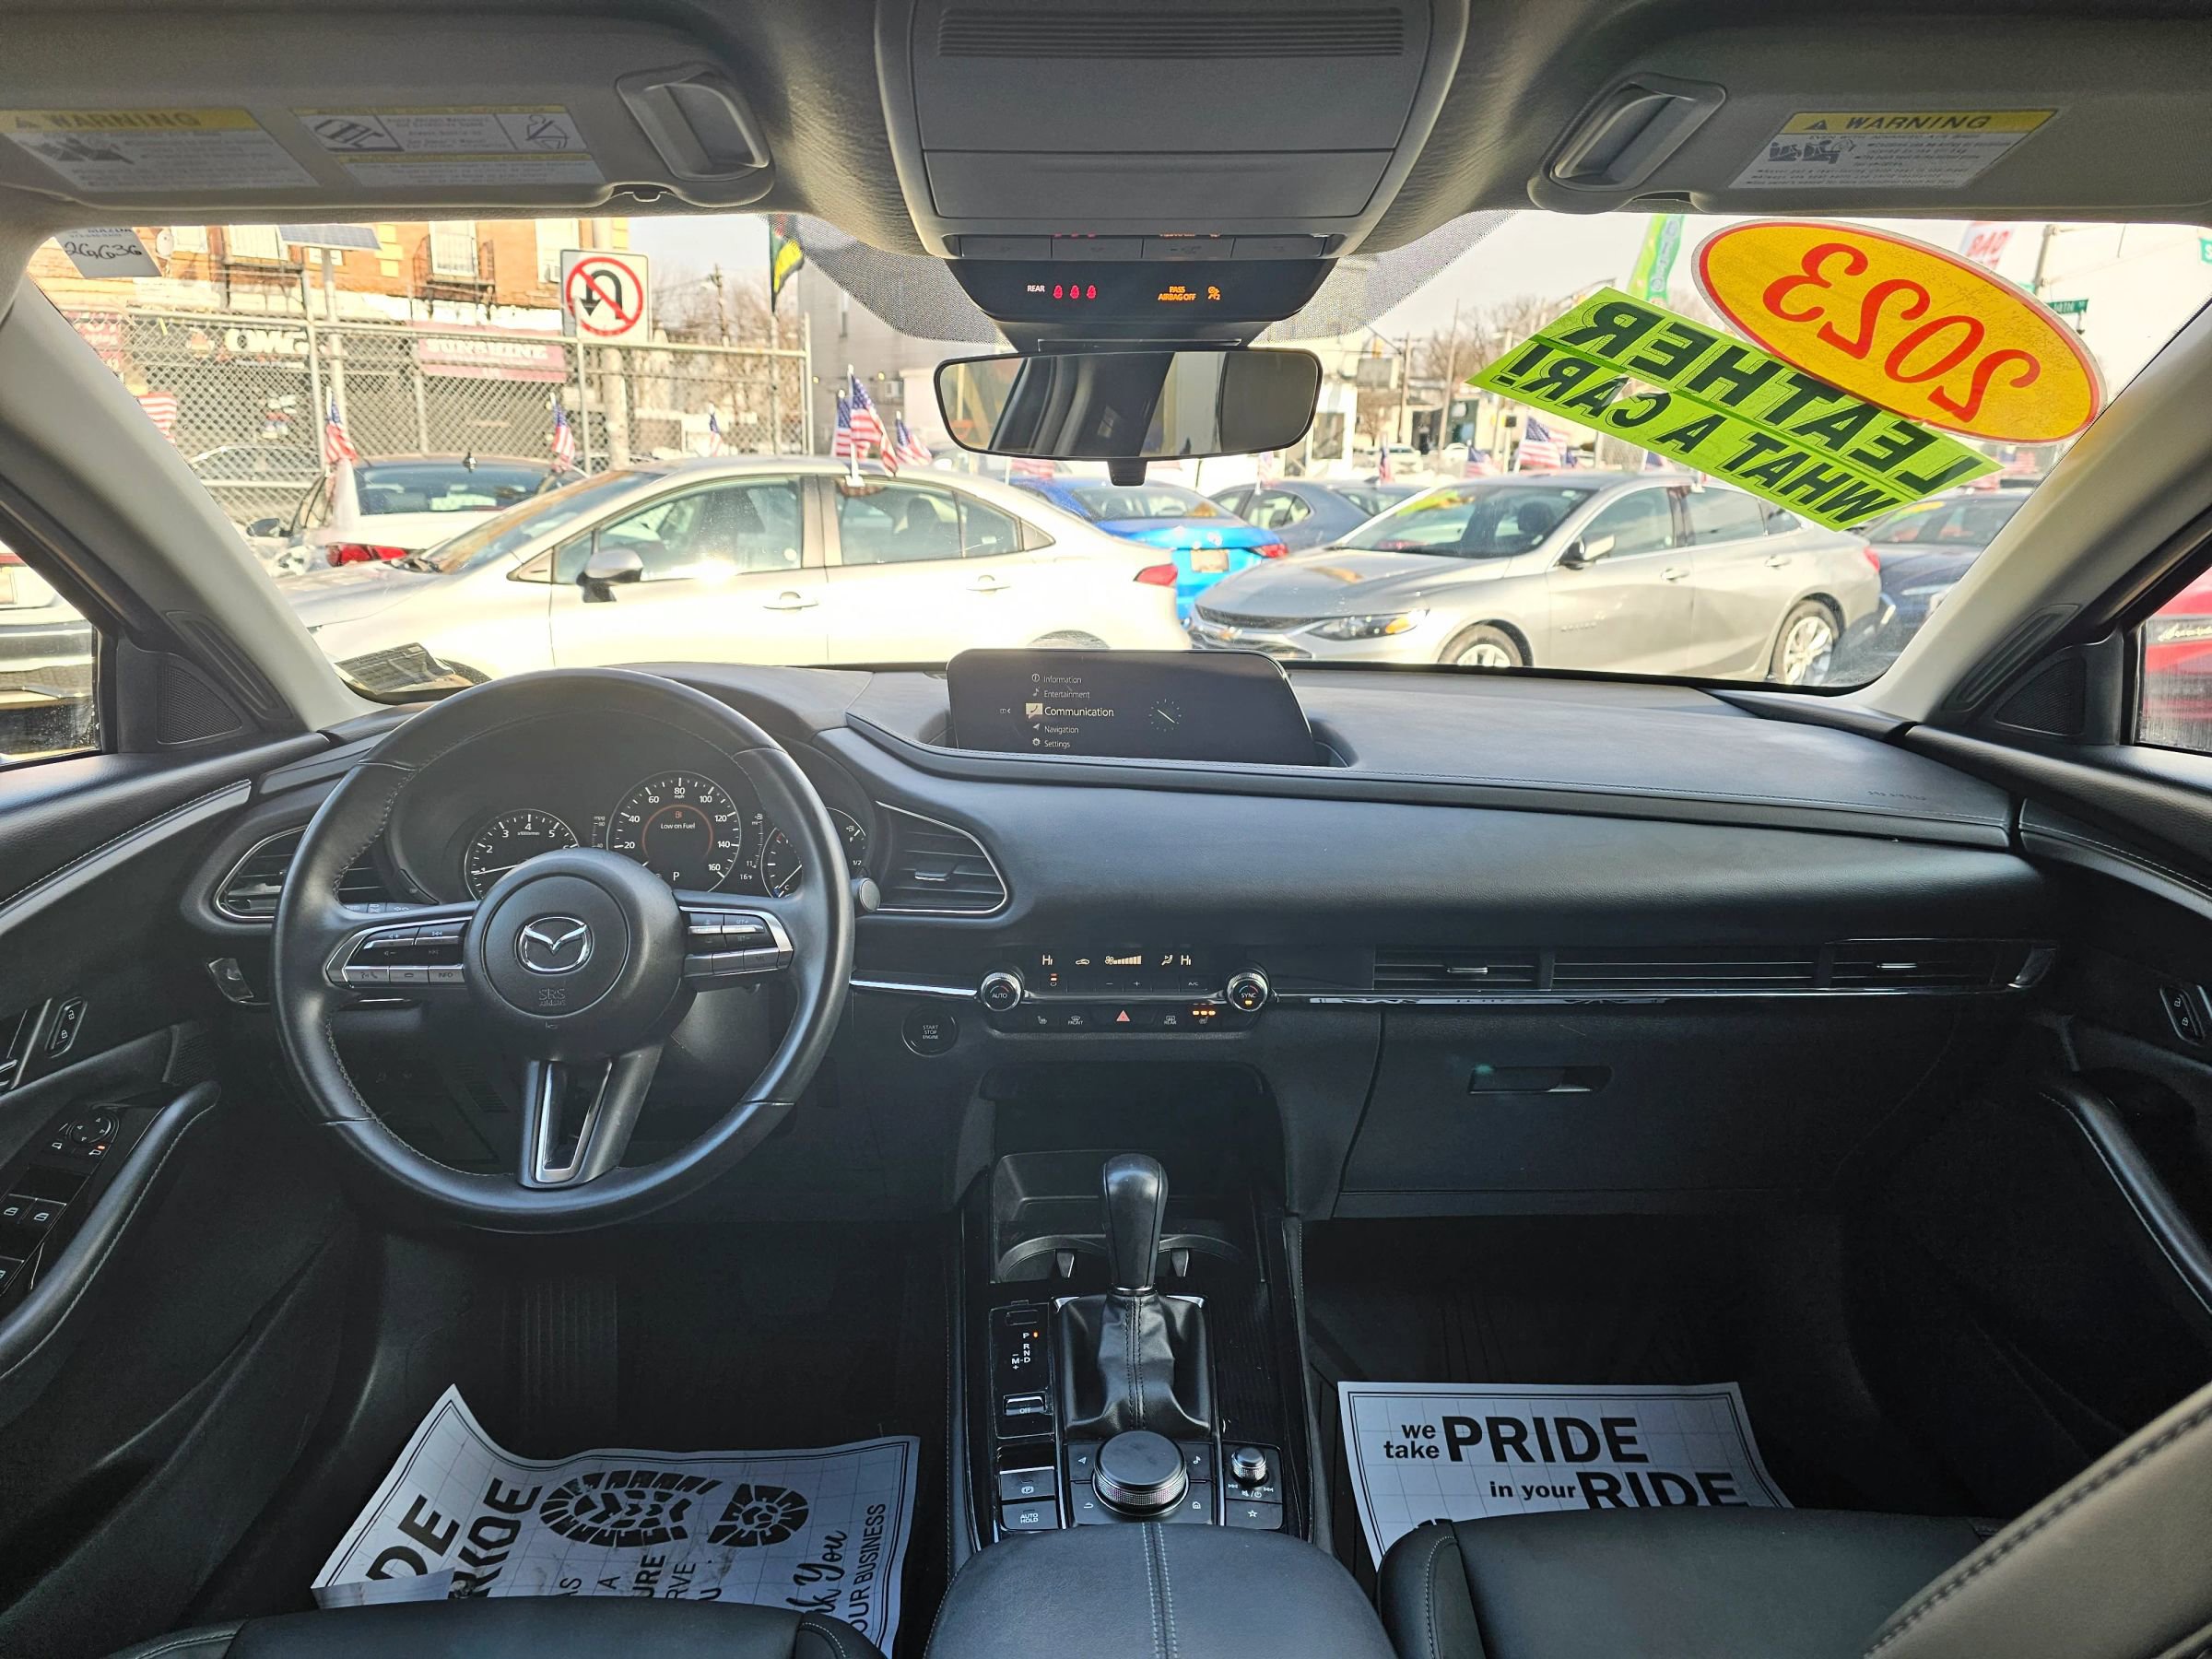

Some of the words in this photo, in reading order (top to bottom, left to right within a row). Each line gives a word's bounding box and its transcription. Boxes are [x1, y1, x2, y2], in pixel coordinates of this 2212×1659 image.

[47, 112, 202, 128] WARNING
[1845, 115, 1993, 131] WARNING
[1027, 284, 1046, 293] REAR
[1169, 286, 1186, 294] PASS
[1158, 293, 1183, 302] AIRBAG
[1182, 293, 1197, 301] OFF
[1043, 675, 1082, 685] Information
[1043, 689, 1090, 700] Entertainment
[1044, 706, 1114, 717] Communication
[1044, 724, 1079, 735] Navigation
[1043, 739, 1071, 749] Settings
[674, 787, 686, 795] 80
[648, 795, 660, 804] 60
[699, 795, 712, 804] 100
[629, 815, 641, 823] 40
[714, 815, 727, 823] 120
[501, 830, 510, 838] 3
[548, 830, 556, 838] 5
[486, 845, 493, 853] 2
[624, 841, 635, 849] 20
[708, 863, 721, 871] 160
[673, 872, 680, 881] P
[538, 988, 566, 1001] SRS
[1401, 1426, 1436, 1440] we
[1441, 1416, 1650, 1464] PRIDE
[1382, 1440, 1441, 1460] take
[1489, 1480, 1513, 1499] in
[1519, 1483, 1577, 1501] your
[1575, 1471, 1749, 1509] RIDE
[853, 1503, 887, 1586] BUSINESS
[793, 1529, 849, 1586] You
